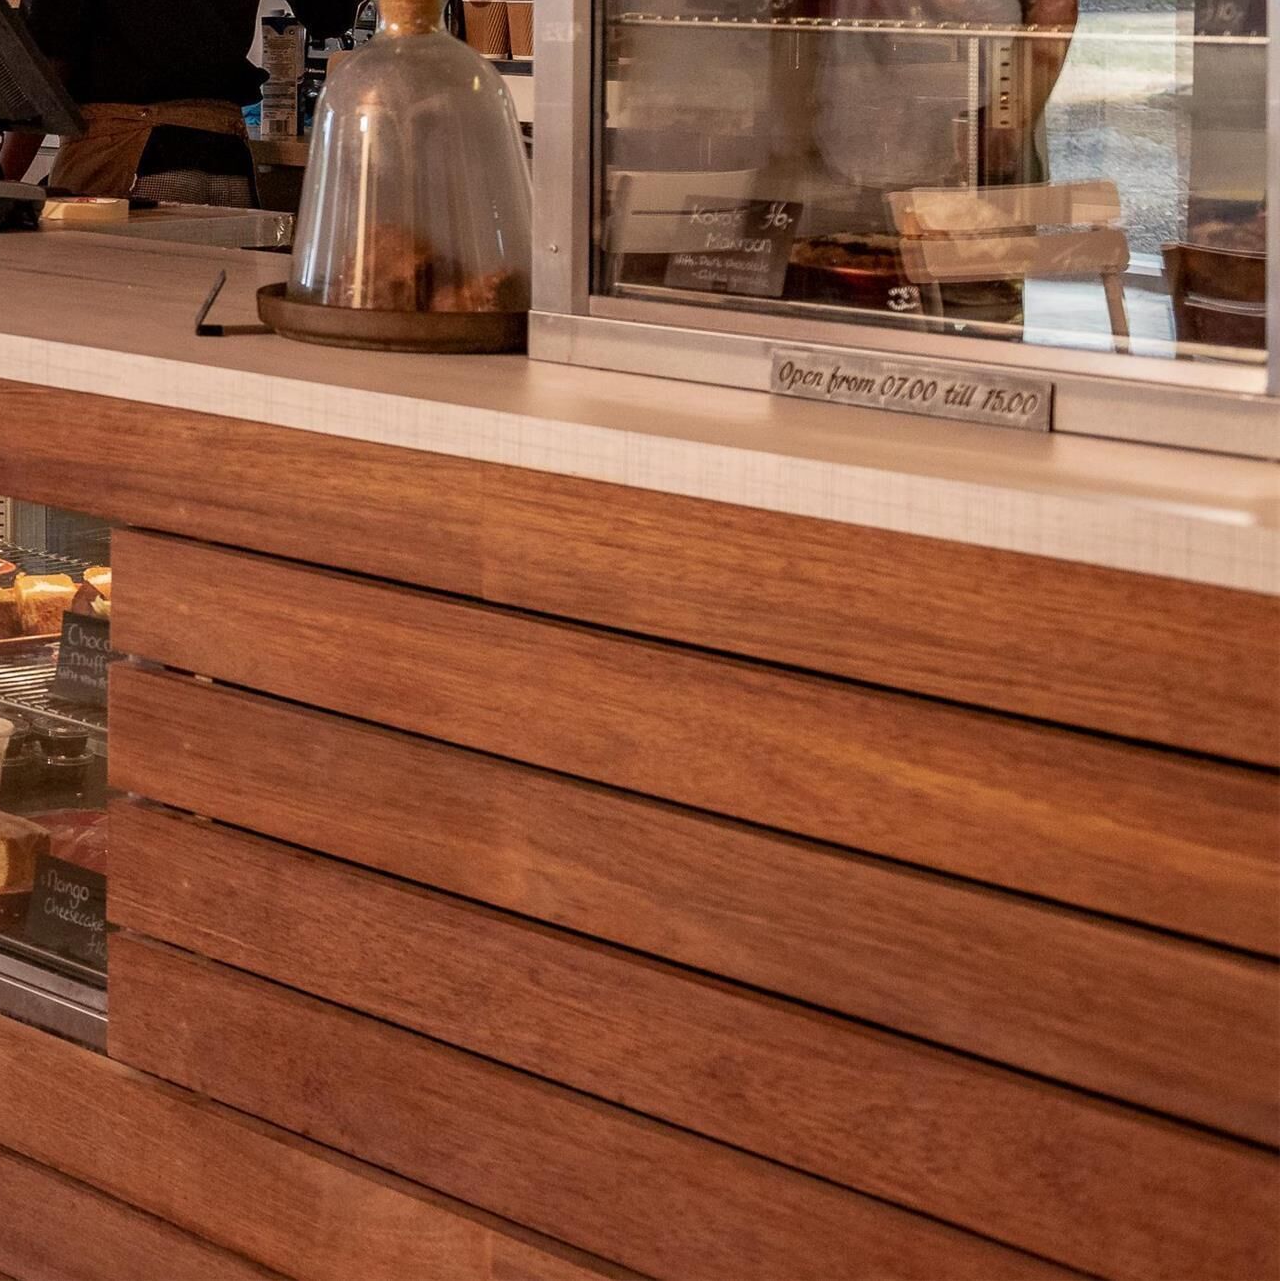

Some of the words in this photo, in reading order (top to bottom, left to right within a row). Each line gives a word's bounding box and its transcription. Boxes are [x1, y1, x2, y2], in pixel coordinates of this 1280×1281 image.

[778, 361, 824, 390] Open
[827, 365, 876, 399] from
[880, 374, 938, 403] 07.00
[944, 383, 977, 408] till
[981, 389, 1039, 416] 15.00
